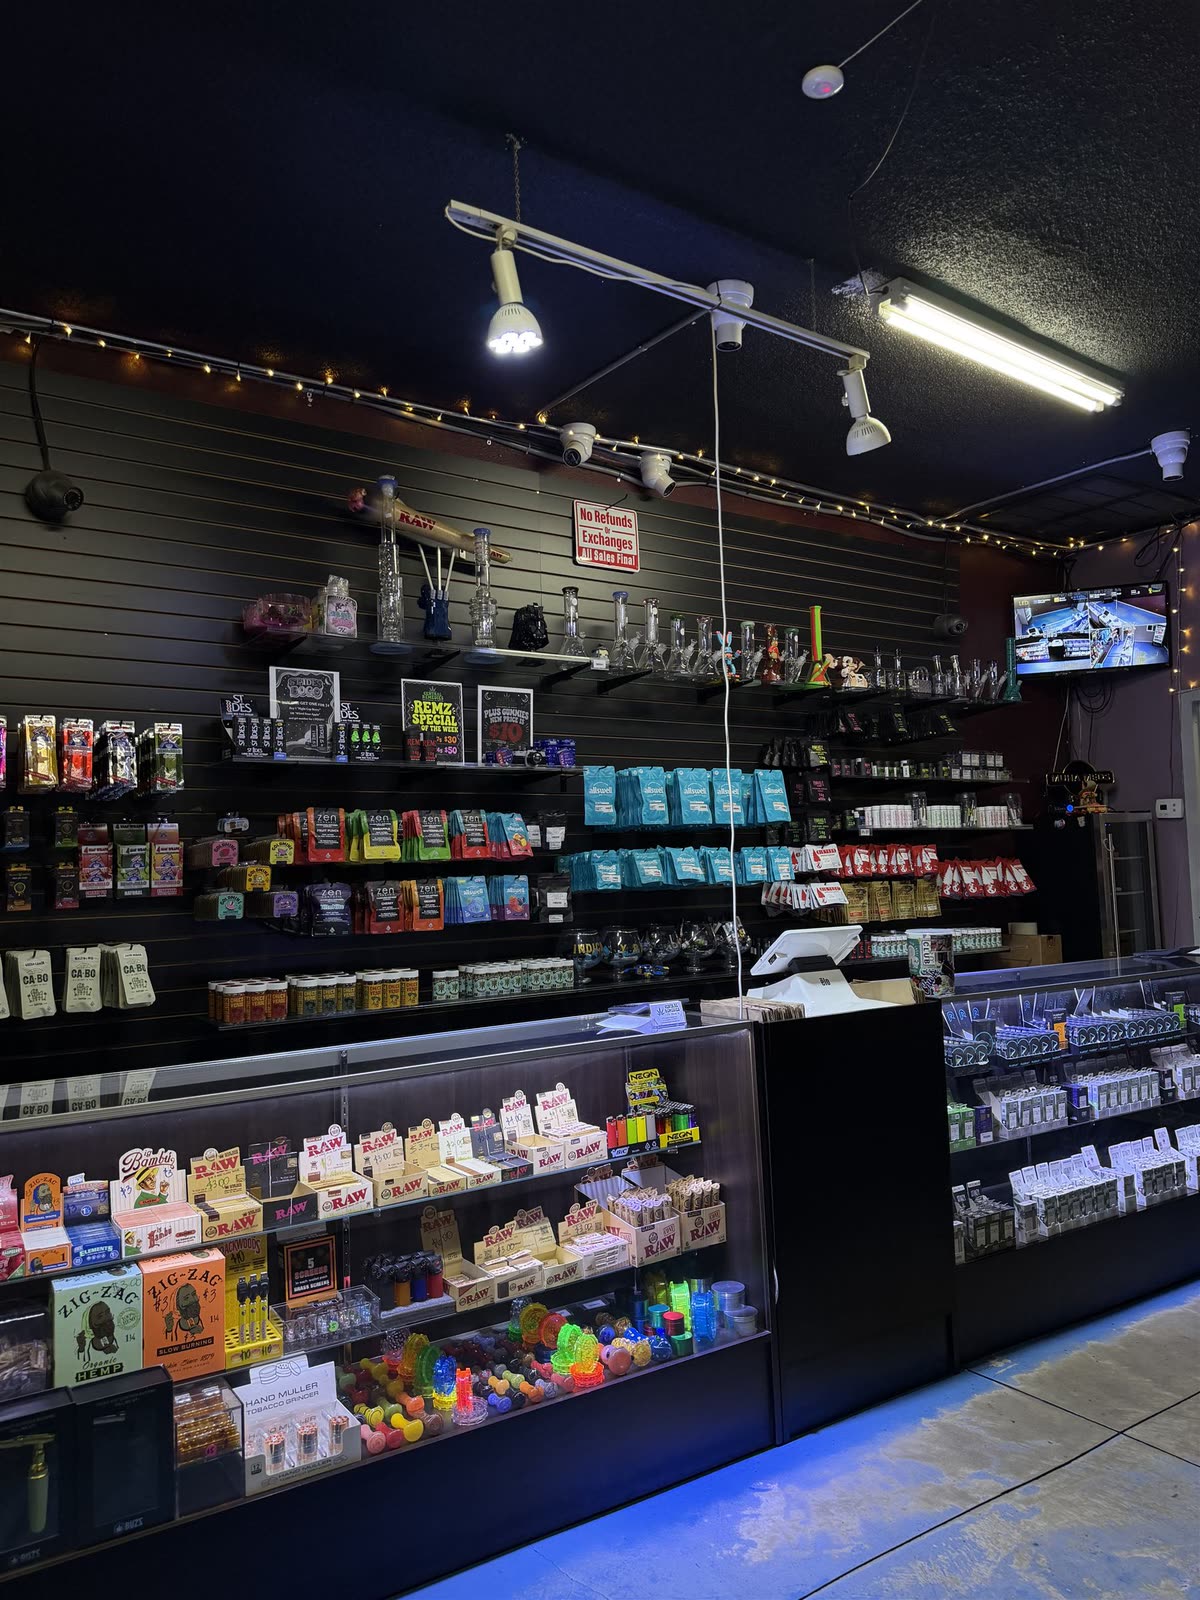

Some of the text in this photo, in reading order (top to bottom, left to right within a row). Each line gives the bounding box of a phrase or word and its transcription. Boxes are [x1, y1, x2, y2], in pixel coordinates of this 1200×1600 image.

[580, 508, 632, 528] No Refunds
[582, 530, 633, 551] Exchanges
[581, 548, 636, 566] All Sales Final
[413, 699, 453, 715] REMZ
[484, 708, 529, 720] PLUS GUMMIES
[412, 714, 457, 726] SPECIAL
[503, 716, 518, 724] PRICE
[444, 736, 457, 744] $30
[489, 722, 523, 743] $10
[444, 746, 457, 754] $50
[684, 787, 707, 795] allswell
[317, 814, 337, 822] zen
[630, 1071, 658, 1080] NEON
[505, 1099, 525, 1112] RAW
[542, 1093, 568, 1111] RAW
[410, 1129, 433, 1143] RAW
[442, 1123, 462, 1136] RAW
[667, 1131, 692, 1141] NEON
[307, 1136, 343, 1158] RAW
[362, 1132, 395, 1153] RAW
[576, 1141, 601, 1159] RAW
[252, 1144, 287, 1165] RAW
[539, 1153, 561, 1167] RAW
[194, 1156, 239, 1179] RAW
[509, 1167, 527, 1179] RAW
[28, 1177, 57, 1188] ZIG-ZAG
[439, 1180, 460, 1193] RAW
[475, 1173, 494, 1185] RAW
[392, 1178, 422, 1198] RAW
[332, 1188, 368, 1210] RAW
[275, 1200, 307, 1220] RAW
[566, 1206, 597, 1227] RAW
[217, 1214, 256, 1236] RAW
[423, 1215, 451, 1232] RAW
[516, 1210, 542, 1228] RAW
[484, 1227, 514, 1247] RAW
[690, 1219, 721, 1241] RAW
[80, 1246, 113, 1257] ELEMENTS
[645, 1234, 675, 1258] RAW
[308, 1258, 314, 1268] 5
[553, 1266, 577, 1283] RAW
[148, 1268, 223, 1299] ZIG-ZAG
[517, 1278, 536, 1291] RAW
[58, 1286, 140, 1319] ZIG-ZAG
[466, 1287, 489, 1304] RAW
[158, 1339, 213, 1355] SLOW BURNING
[82, 1356, 117, 1370] Organic
[77, 1365, 123, 1381] HEMP
[245, 1382, 318, 1408] HAND MULLER
[247, 1391, 319, 1416] TOBACCO GRINDER
